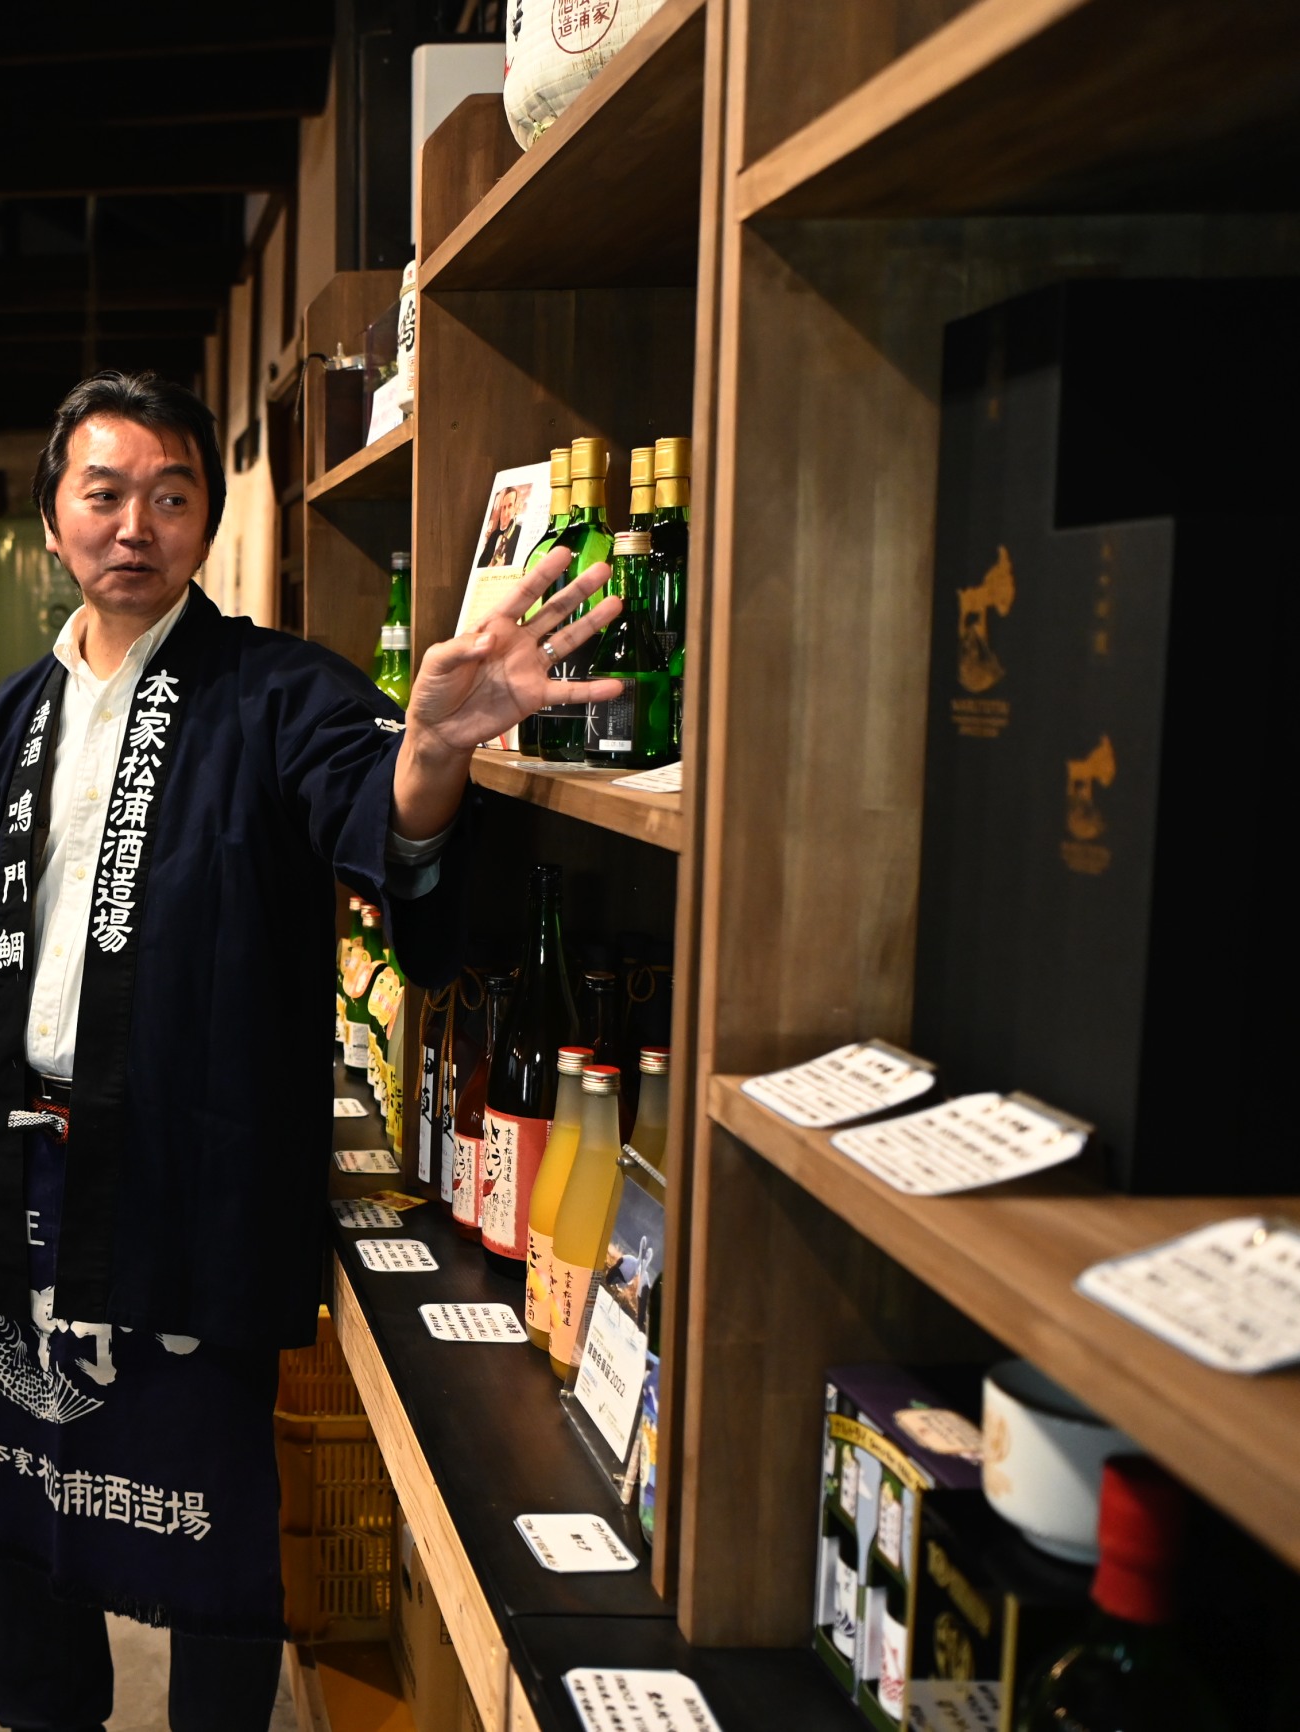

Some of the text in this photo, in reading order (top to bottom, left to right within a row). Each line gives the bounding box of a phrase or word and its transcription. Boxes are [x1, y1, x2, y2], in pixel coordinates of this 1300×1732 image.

[20, 699, 52, 769] 清酒
[91, 669, 180, 954] 本家松浦酒造場
